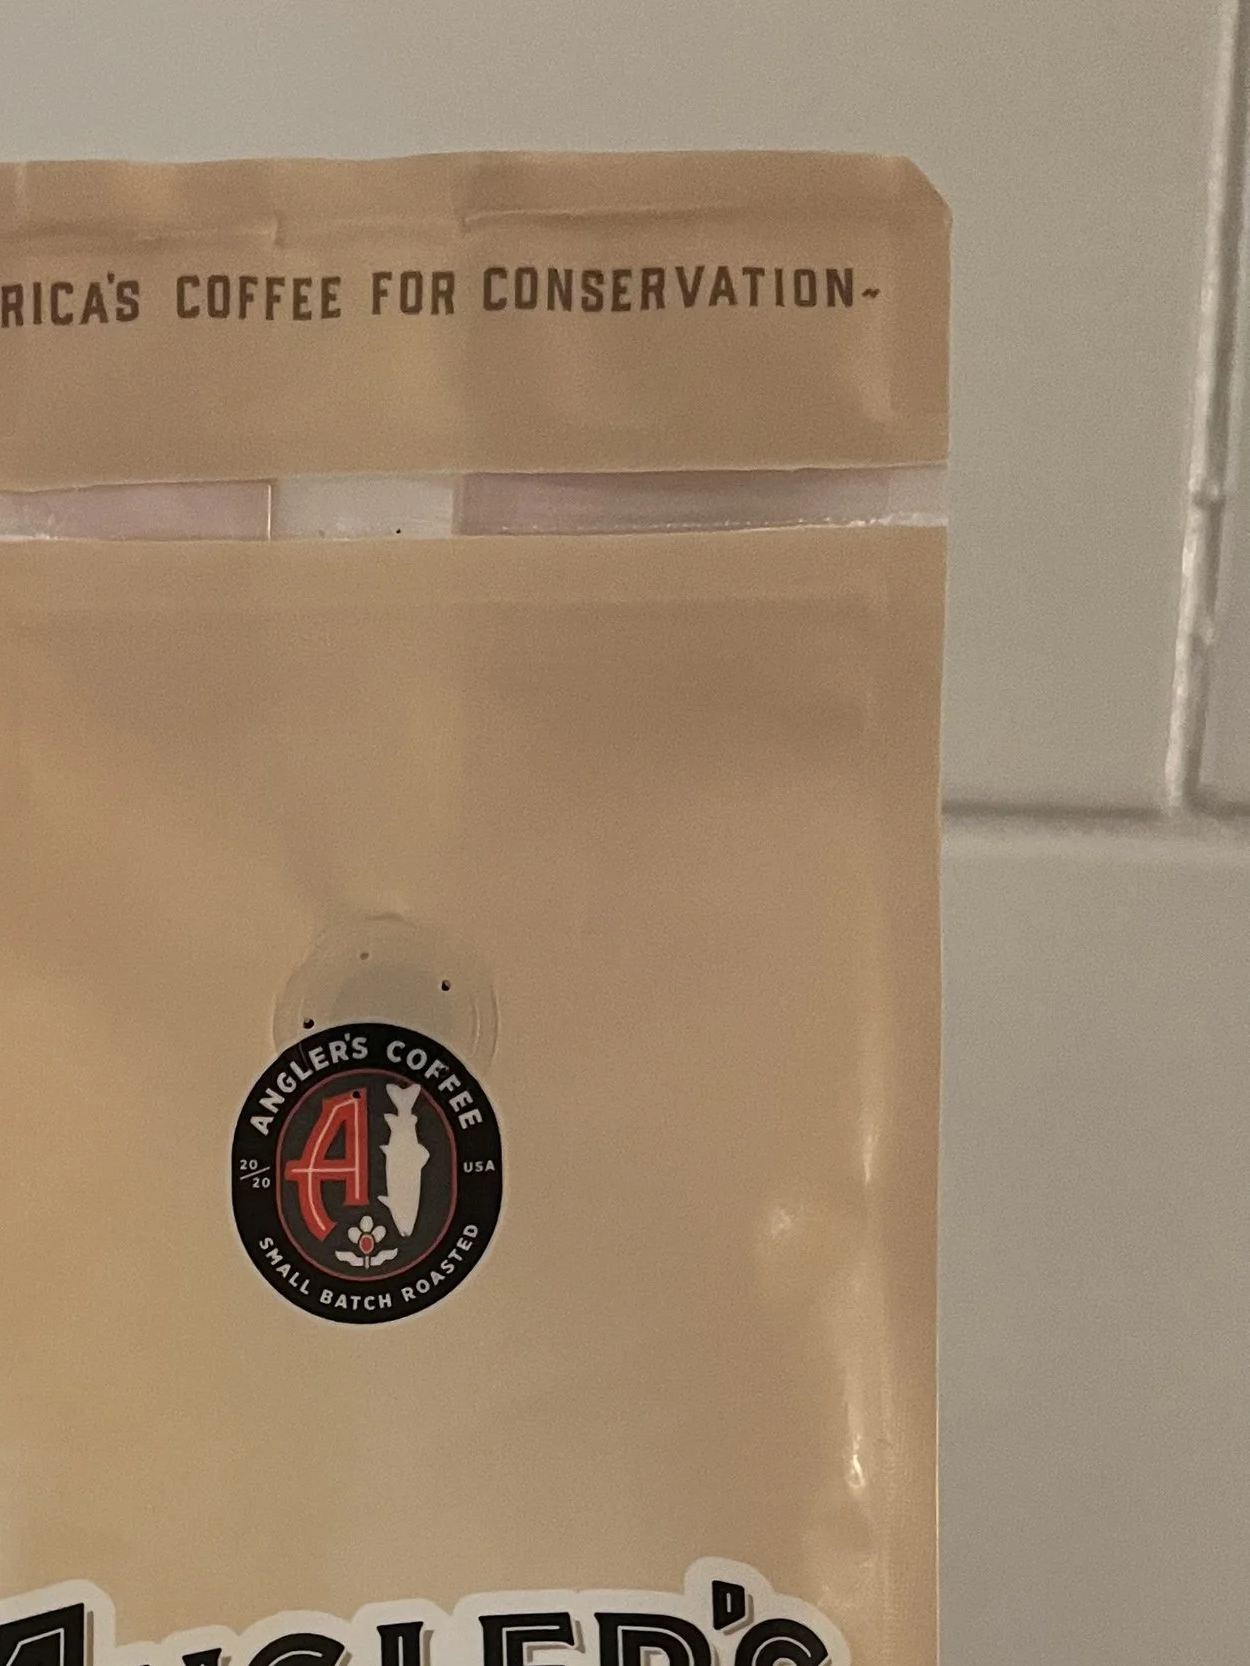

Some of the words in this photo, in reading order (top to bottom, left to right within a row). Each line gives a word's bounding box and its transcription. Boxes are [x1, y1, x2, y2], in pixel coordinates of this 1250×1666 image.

[176, 274, 342, 321] COFFEE
[371, 270, 456, 316] FOR
[249, 1033, 369, 1136] ANGLER'S
[386, 1040, 483, 1130] COFFEE
[463, 1159, 496, 1174] USA
[258, 1237, 312, 1296] SMALL
[319, 1288, 393, 1311] BATCH
[400, 1223, 479, 1303] ROASTED
